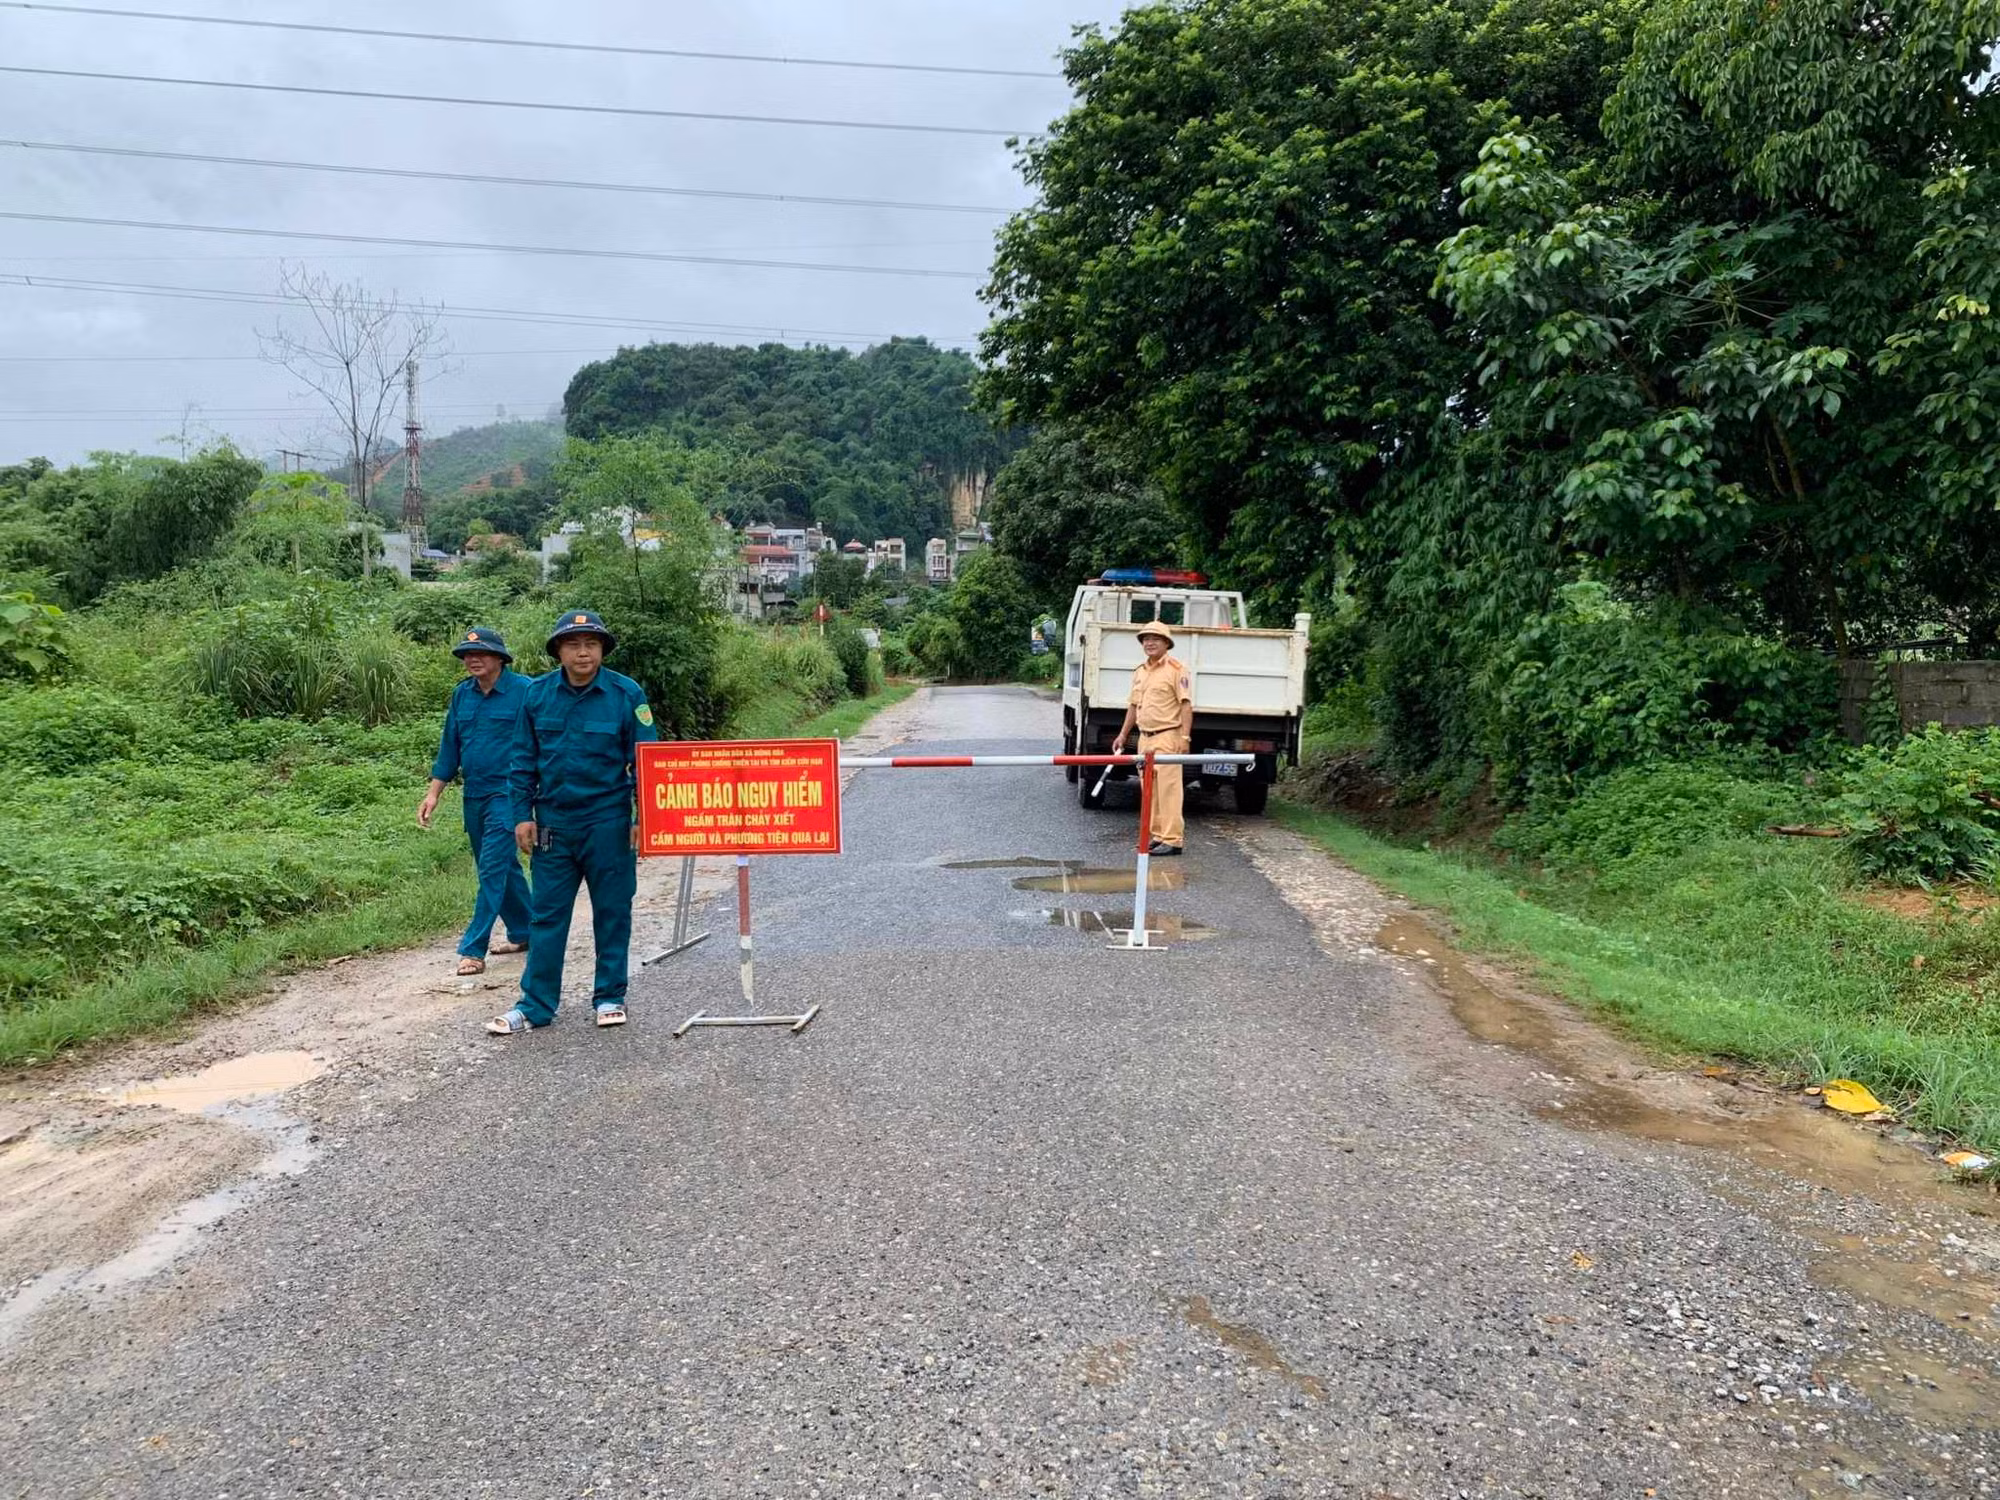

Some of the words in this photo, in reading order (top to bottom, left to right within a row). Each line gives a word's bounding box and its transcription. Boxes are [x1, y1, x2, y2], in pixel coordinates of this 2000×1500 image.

[655, 772, 698, 810] CẢNH
[702, 776, 733, 809] BÁO
[737, 781, 778, 809] NGUY
[783, 770, 822, 808] HIỂM
[745, 809, 771, 826] CHẢY
[773, 809, 795, 826] XIẾT
[651, 831, 674, 846] CẤM
[676, 830, 707, 846] NGƯỜI
[709, 830, 722, 845] VÀ
[767, 829, 789, 847] TIỆN
[791, 831, 812, 845] QUA
[814, 831, 830, 847] LẠI
